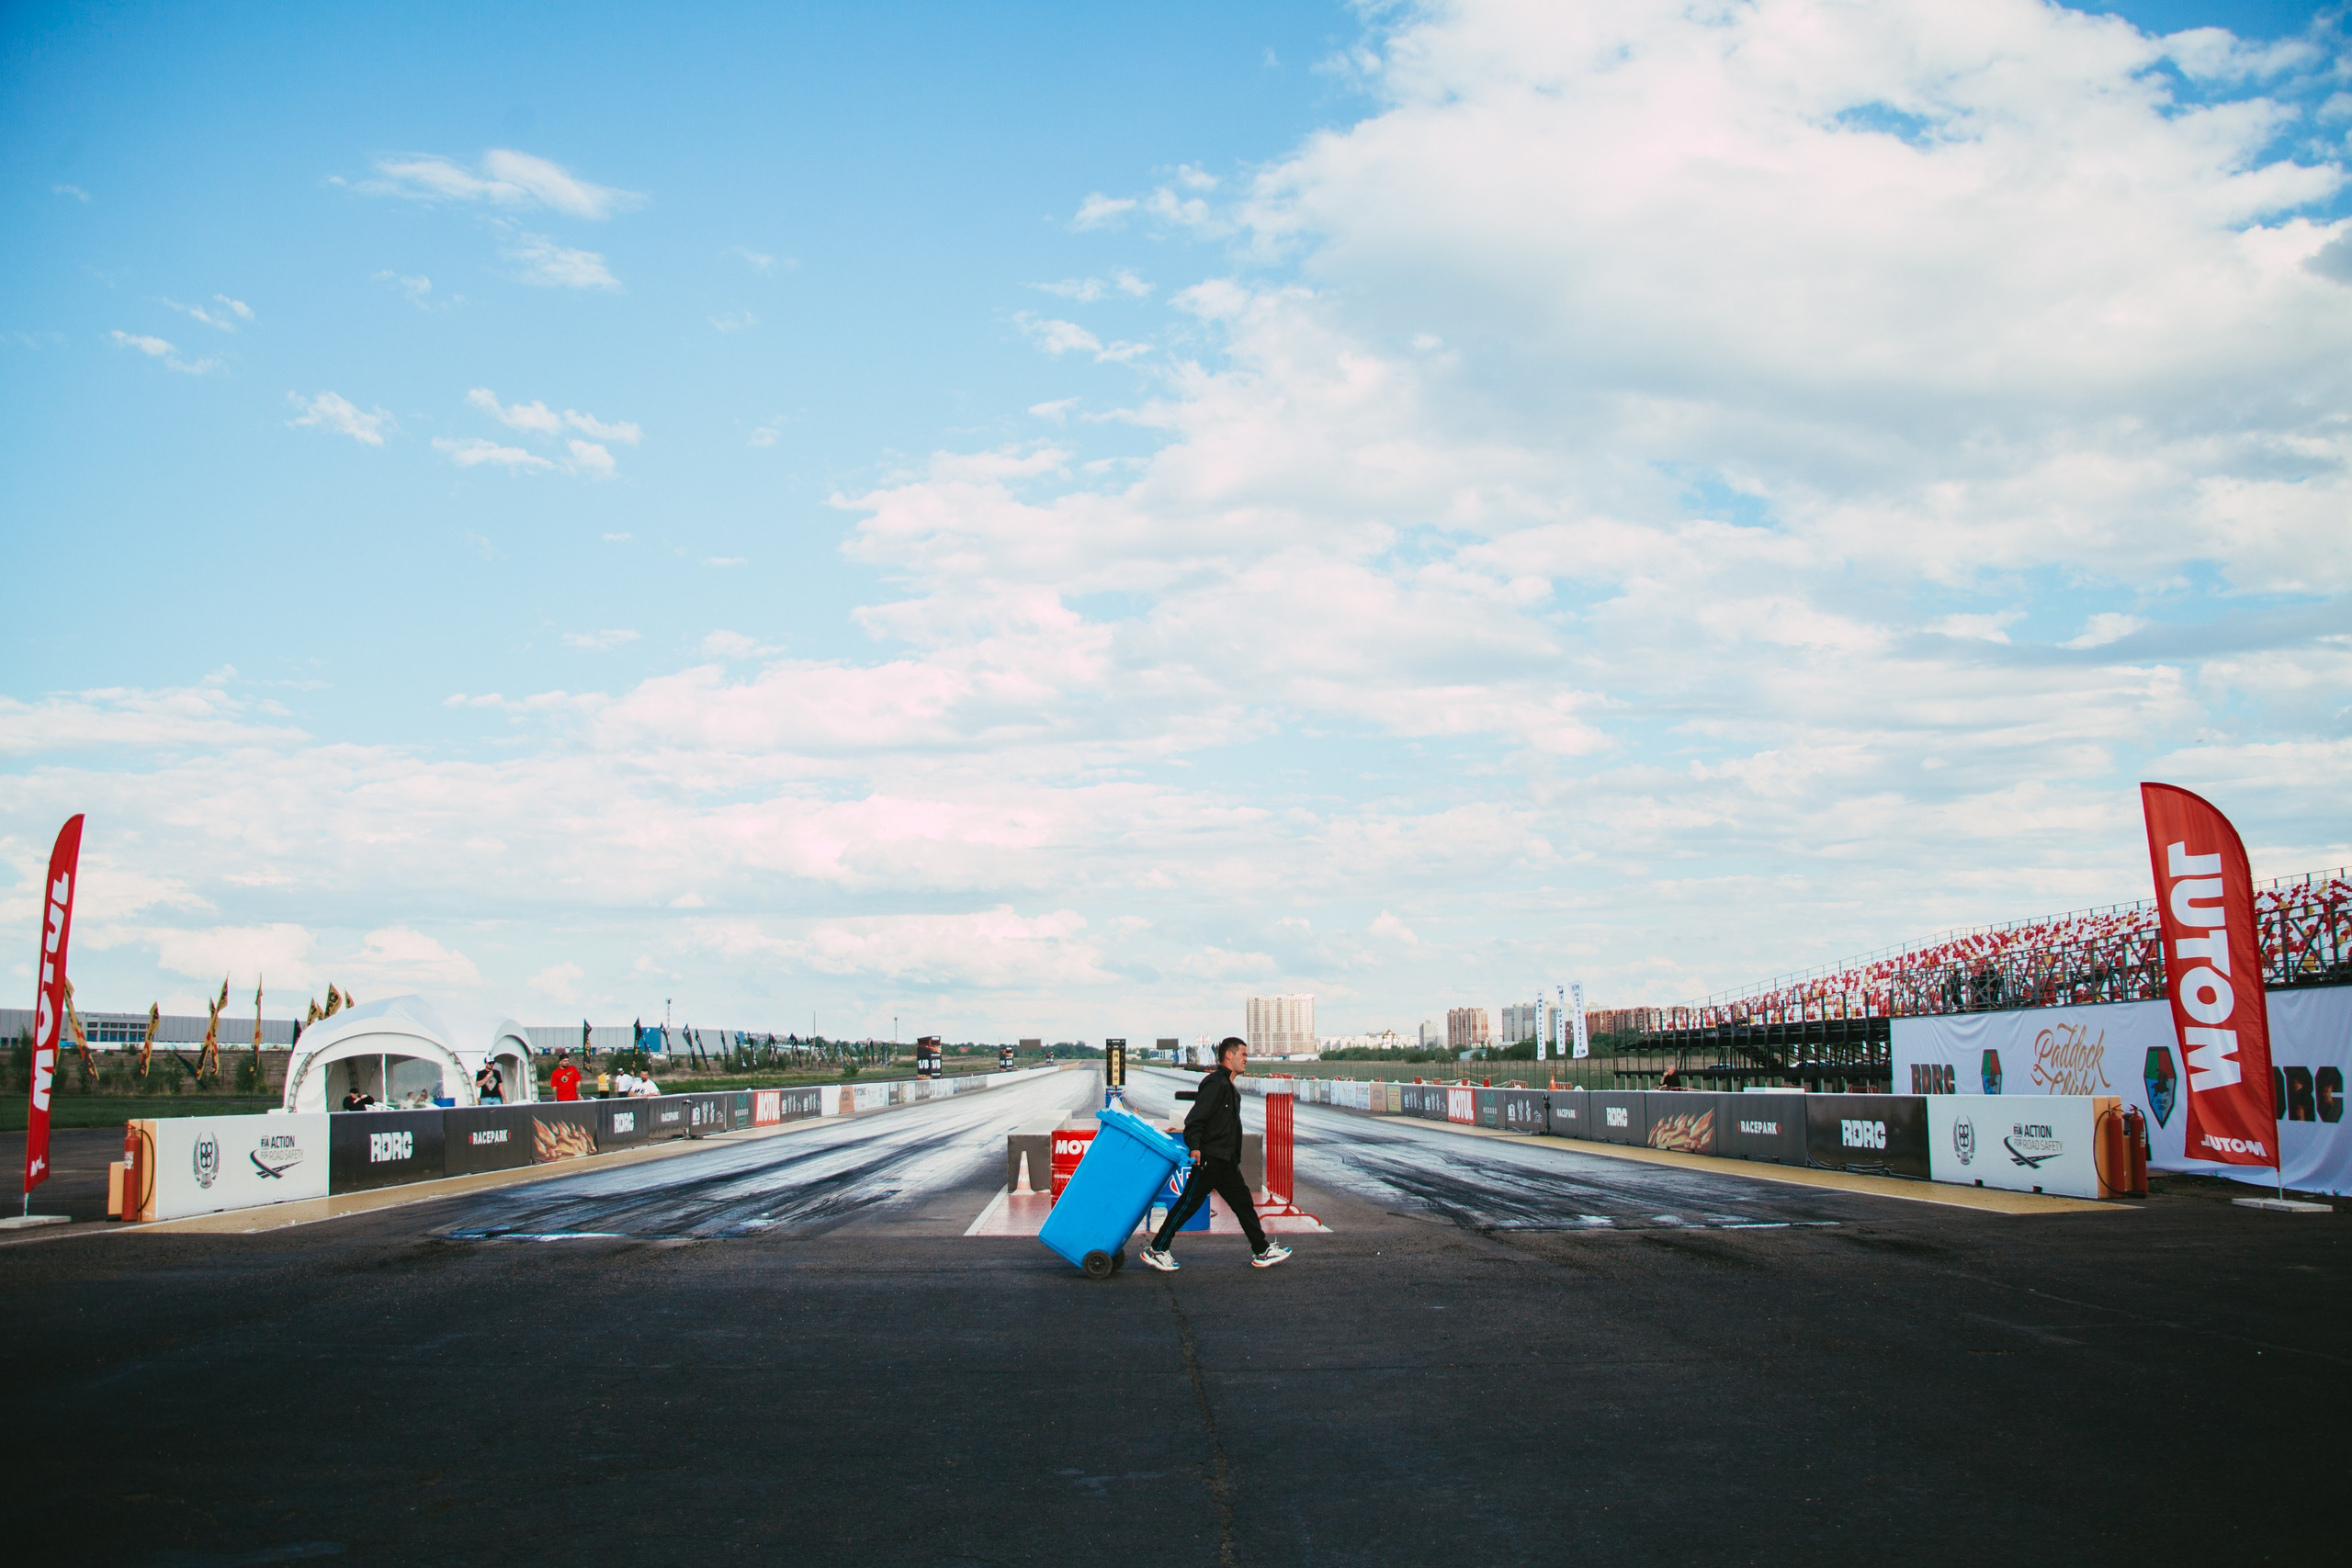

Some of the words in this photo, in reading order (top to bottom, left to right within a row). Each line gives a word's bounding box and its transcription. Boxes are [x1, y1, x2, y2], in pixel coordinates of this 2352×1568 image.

[918, 1059, 929, 1069] 1/8
[931, 1059, 941, 1069] 1/8
[2034, 1022, 2110, 1089] Paddock
[1910, 1064, 1955, 1095] RDRC
[2273, 1066, 2344, 1123] RC
[756, 1092, 780, 1122] MOTUL
[1449, 1089, 1474, 1120] MOTUL
[614, 1111, 634, 1134] RDRC
[1606, 1107, 1628, 1127] RDRC
[1740, 1120, 1778, 1135] RACEPARK
[1840, 1119, 1886, 1149] RDRC
[2024, 1124, 2052, 1138] ACTION
[271, 1135, 295, 1148] ACTION
[472, 1129, 508, 1145] RACEPARK
[2022, 1139, 2040, 1150] ROAD
[2040, 1140, 2063, 1151] SAFETY
[269, 1150, 284, 1160] ROAD
[285, 1149, 304, 1159] SAFETY
[370, 1131, 413, 1163] RDRC
[1056, 1139, 1092, 1155] MOT
